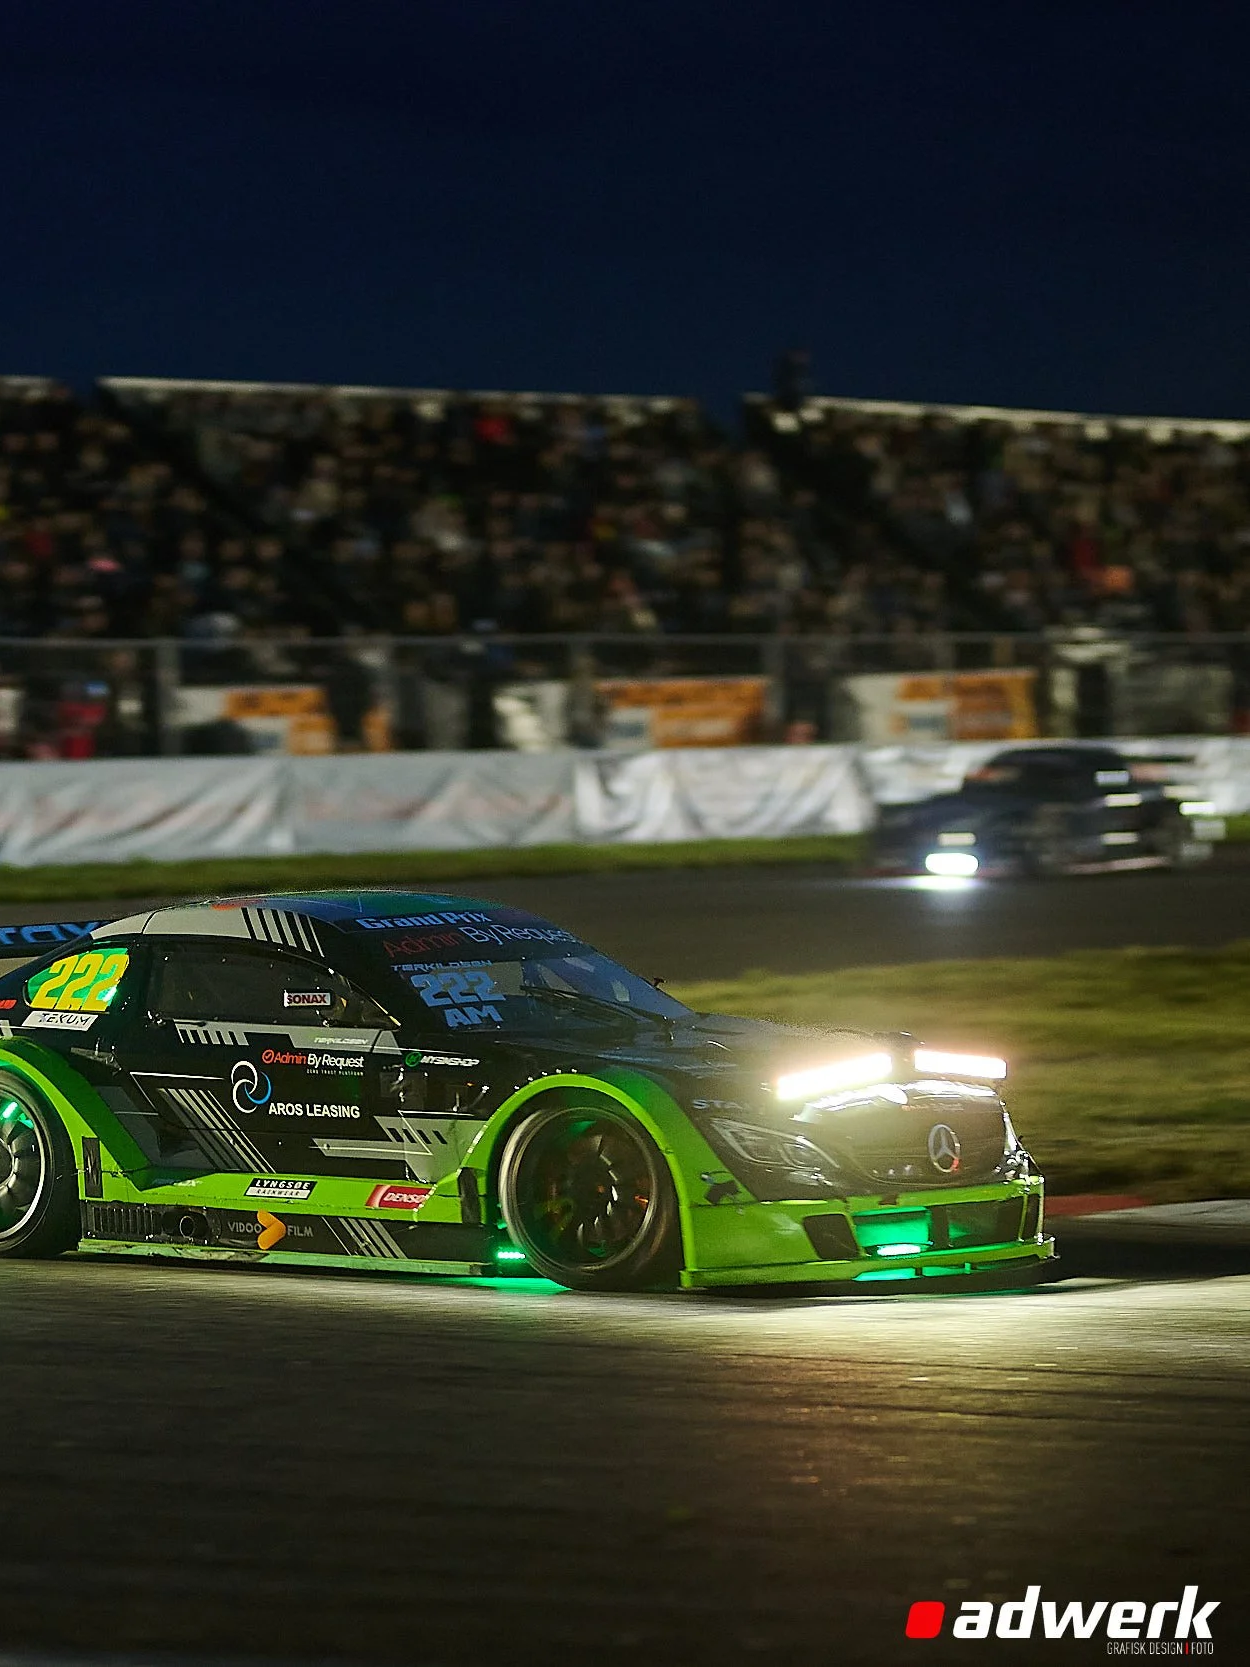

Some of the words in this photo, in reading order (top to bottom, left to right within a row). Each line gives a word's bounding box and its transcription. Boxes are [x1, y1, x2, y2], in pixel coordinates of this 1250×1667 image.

[383, 932, 467, 958] Admin
[30, 953, 130, 1012] 222
[410, 971, 507, 1008] 222
[287, 994, 327, 1005] SONAX
[442, 1004, 504, 1028] AM
[273, 1052, 306, 1066] Admin
[307, 1053, 322, 1070] By
[322, 1053, 365, 1070] Request
[268, 1102, 304, 1117] AROS
[306, 1103, 361, 1119] LEASING
[227, 1222, 263, 1234] VIDOO
[286, 1224, 314, 1237] FILM
